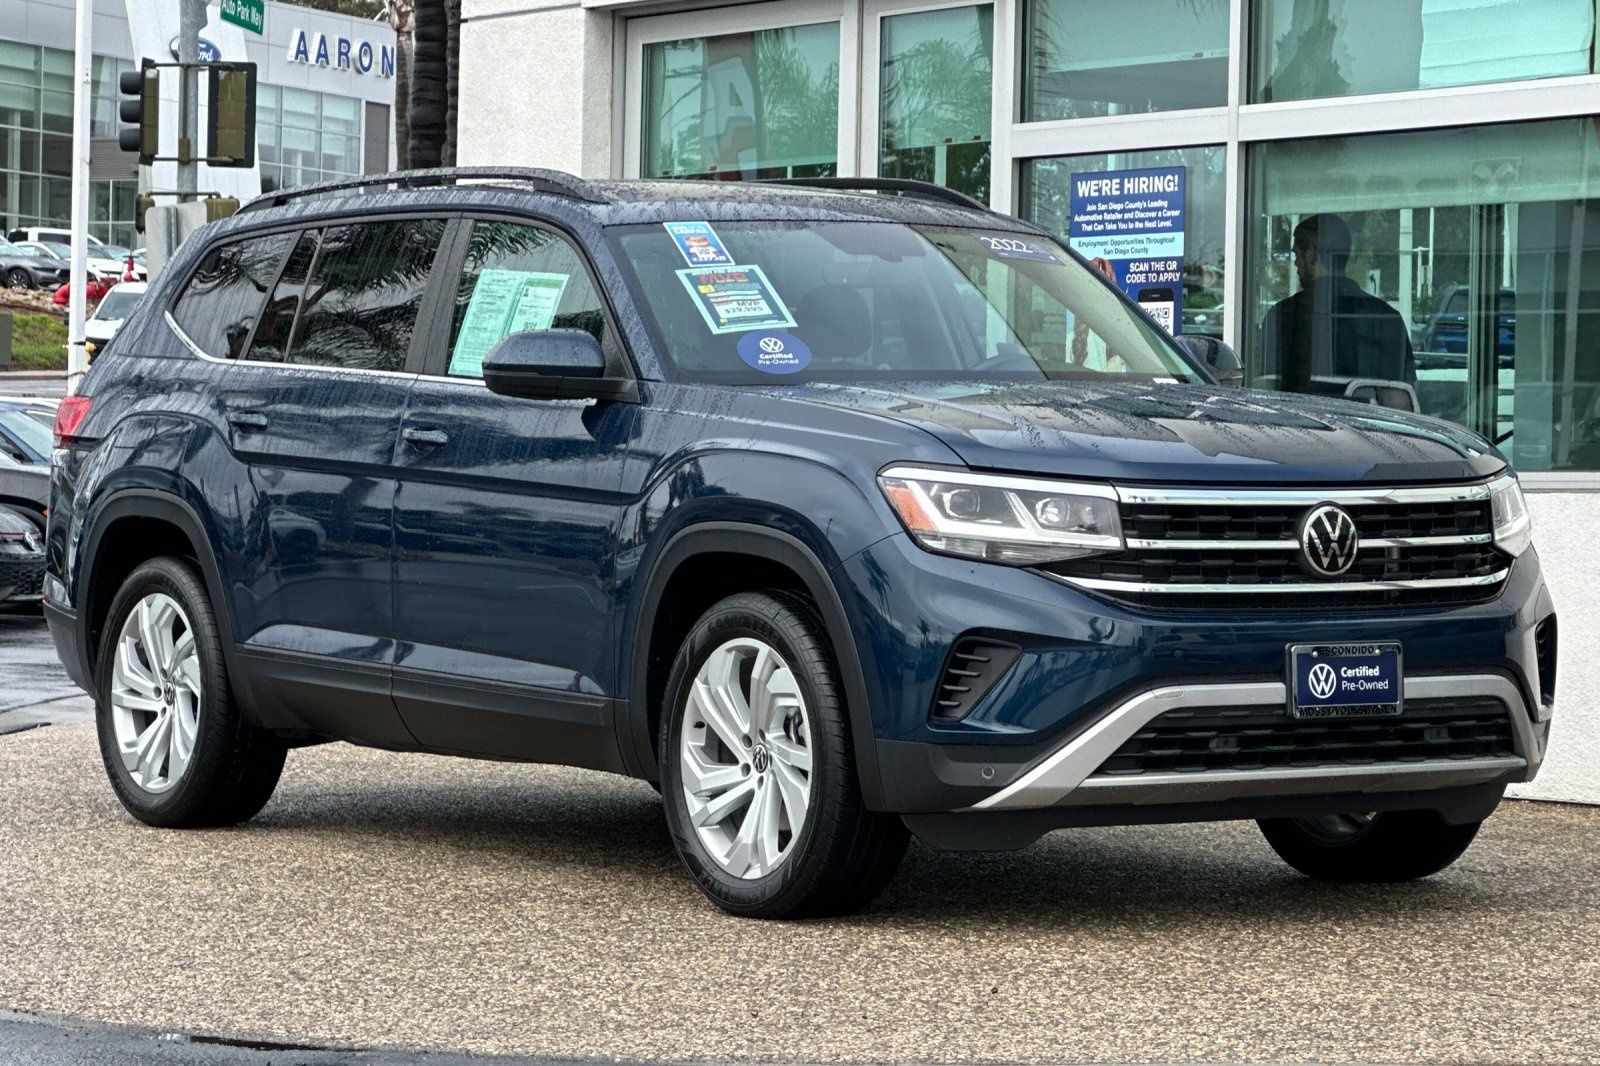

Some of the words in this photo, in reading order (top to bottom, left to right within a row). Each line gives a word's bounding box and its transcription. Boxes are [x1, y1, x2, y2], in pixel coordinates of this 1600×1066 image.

[221, 0, 235, 16] Auto
[237, 0, 250, 21] Park
[250, 7, 263, 31] Way
[290, 29, 394, 78] AARON
[1077, 178, 1121, 197] WE'RE
[1123, 174, 1179, 194] HIRING!
[1086, 203, 1096, 212] Join
[1097, 203, 1107, 211] San
[1109, 202, 1124, 211] Diego
[1125, 200, 1147, 209] County's
[1148, 199, 1168, 208] Leading
[1074, 213, 1103, 222] Automotive
[1104, 212, 1123, 220] Retailer
[1124, 211, 1134, 219] and
[1135, 210, 1157, 219] Discover
[1163, 209, 1180, 217] Career
[1081, 224, 1093, 232] That
[1094, 223, 1104, 231] Can
[1105, 222, 1117, 231] Take
[1118, 222, 1127, 230] You
[1135, 221, 1143, 229] the
[1144, 220, 1157, 228] Next
[1078, 239, 1109, 249] Employment
[1109, 238, 1145, 247] Opportunities
[1146, 236, 1175, 246] Throughout
[1104, 247, 1113, 256] San
[1115, 247, 1129, 256] Diego
[1131, 246, 1148, 255] County
[1129, 261, 1149, 272] SCAN
[1150, 261, 1165, 271] THE
[1166, 260, 1177, 271] QR
[1126, 273, 1146, 284] CODE
[1148, 273, 1158, 283] TO
[1158, 272, 1181, 282] APPLY
[1341, 665, 1379, 677] Certified
[1342, 679, 1388, 690] Pre-Owned
